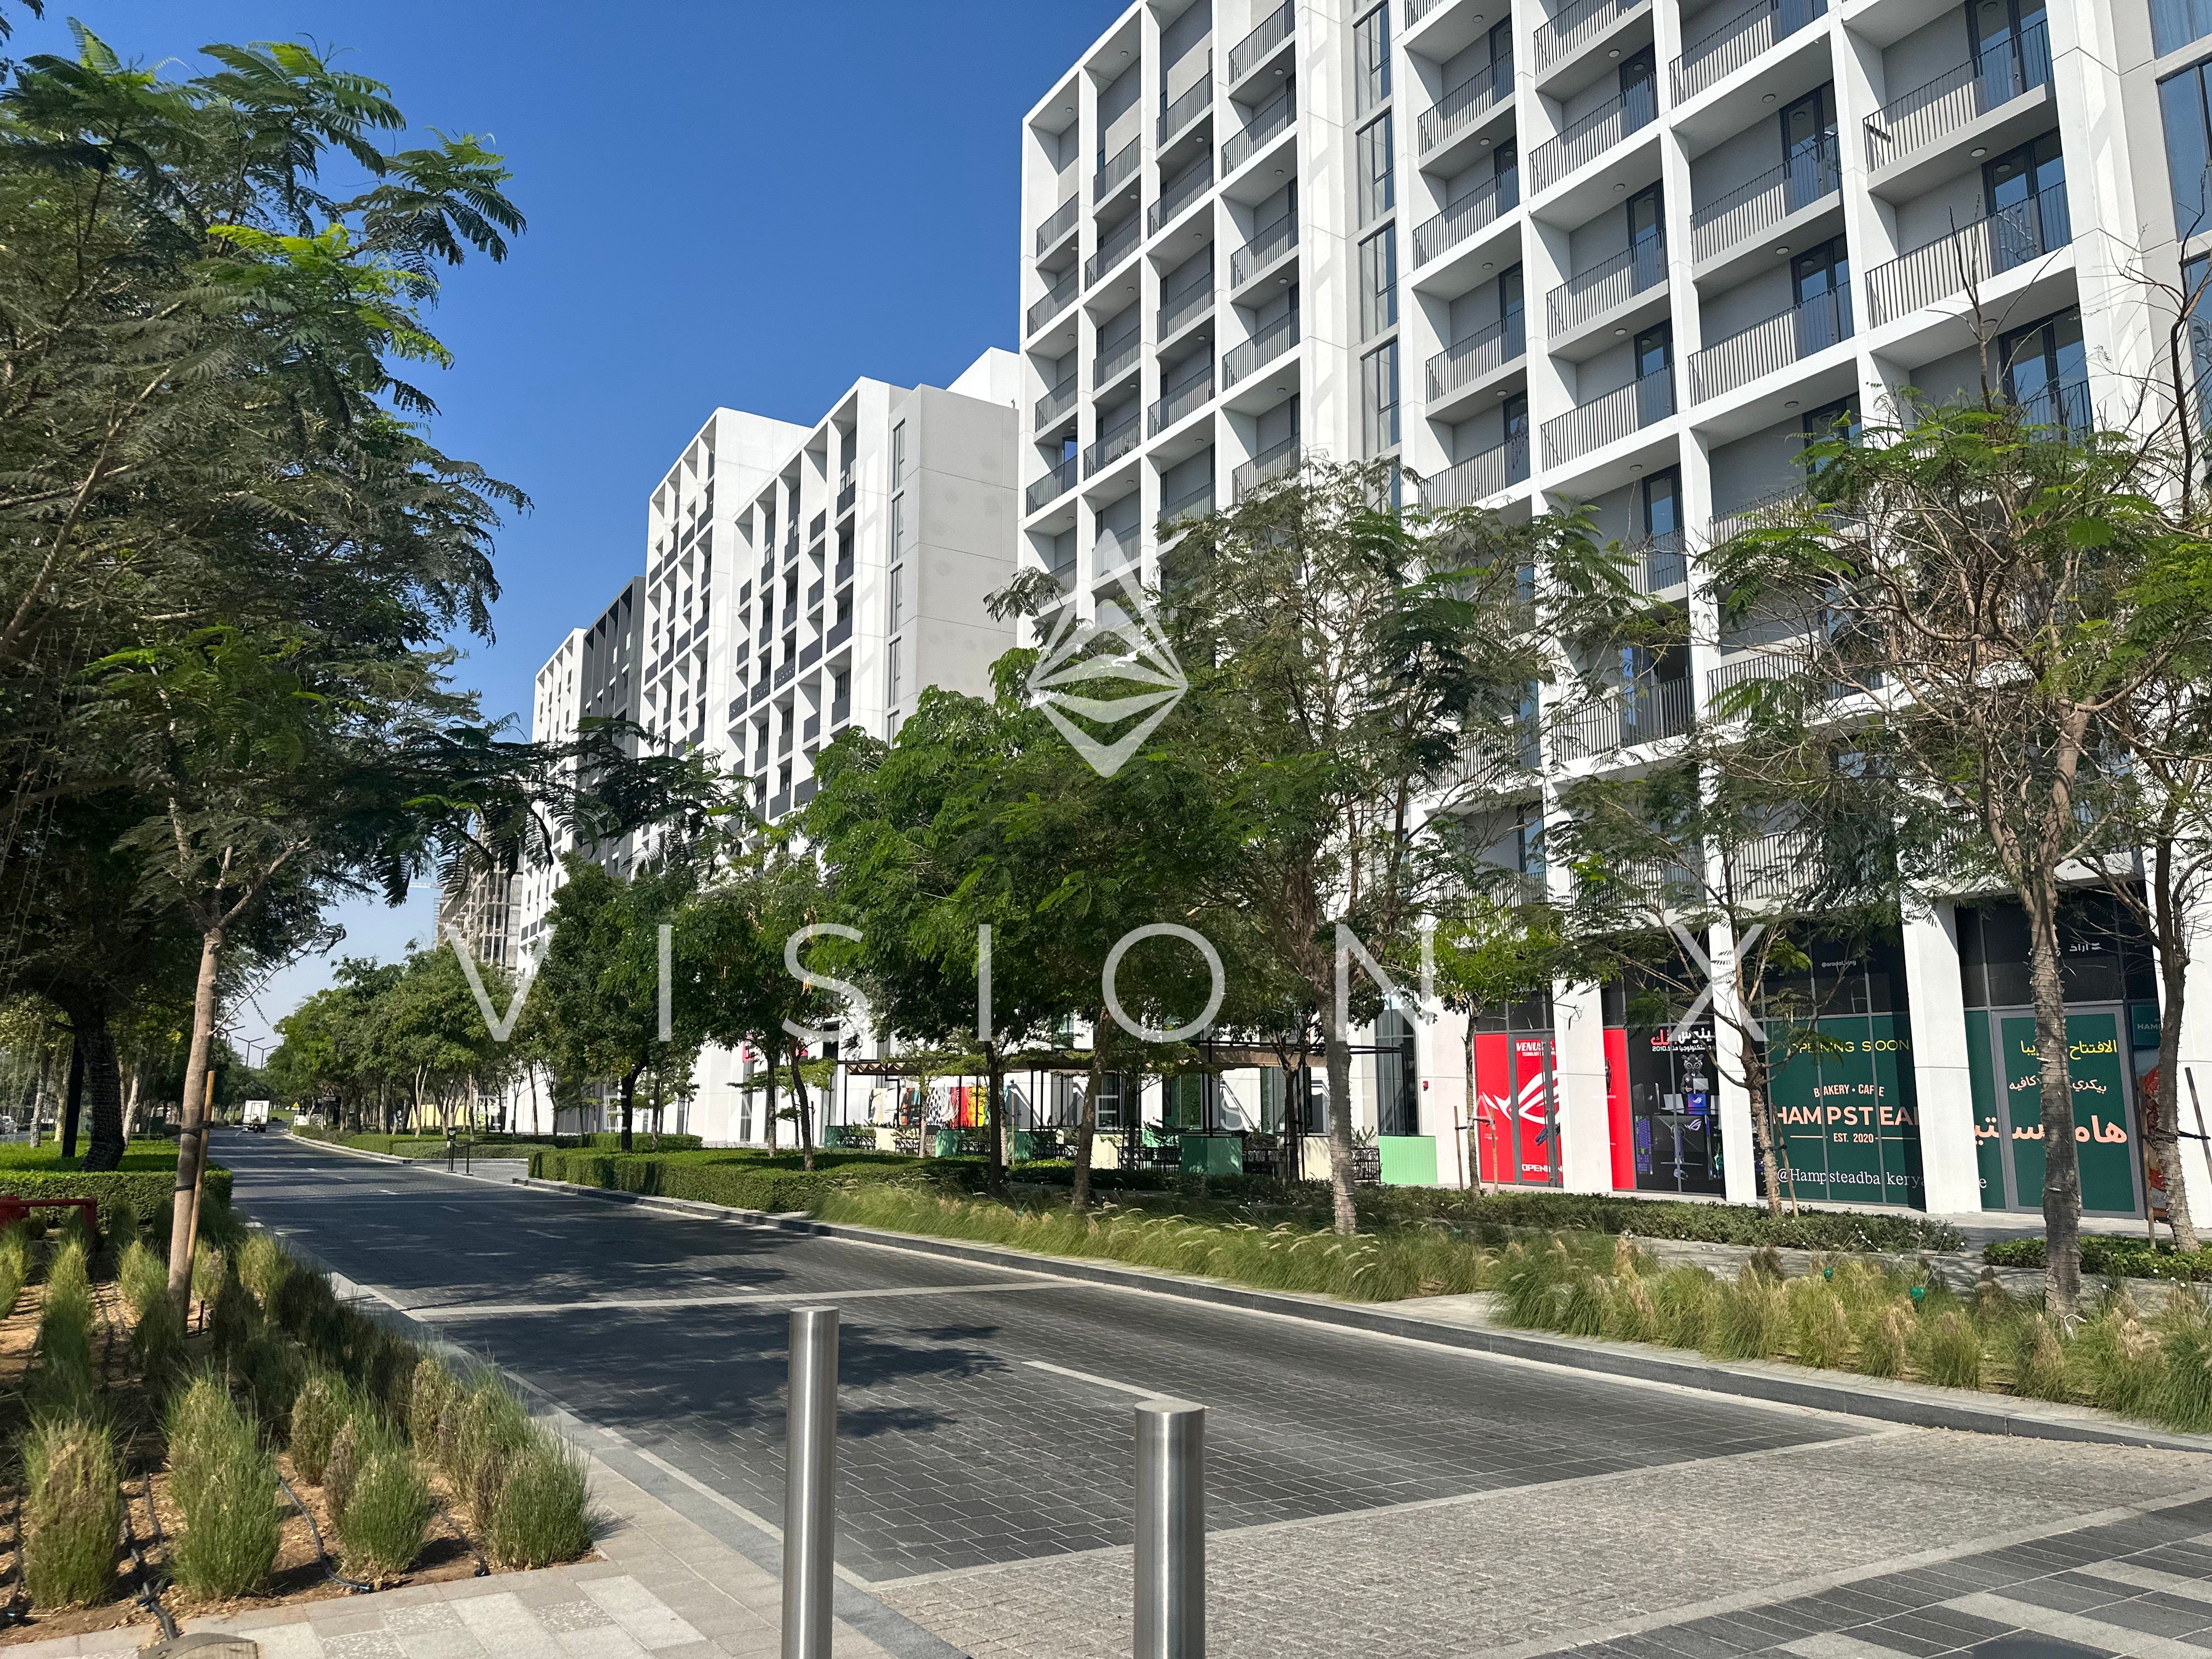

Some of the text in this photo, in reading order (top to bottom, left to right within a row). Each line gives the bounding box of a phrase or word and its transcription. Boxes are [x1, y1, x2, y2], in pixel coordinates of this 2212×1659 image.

[1792, 1040, 1909, 1053] PENNG SOON
[2020, 1039, 2117, 1060] الافتتاح يبا
[1813, 1084, 1885, 1098] BAKERY CAFE
[1833, 1132, 1874, 1143] EST. 2020
